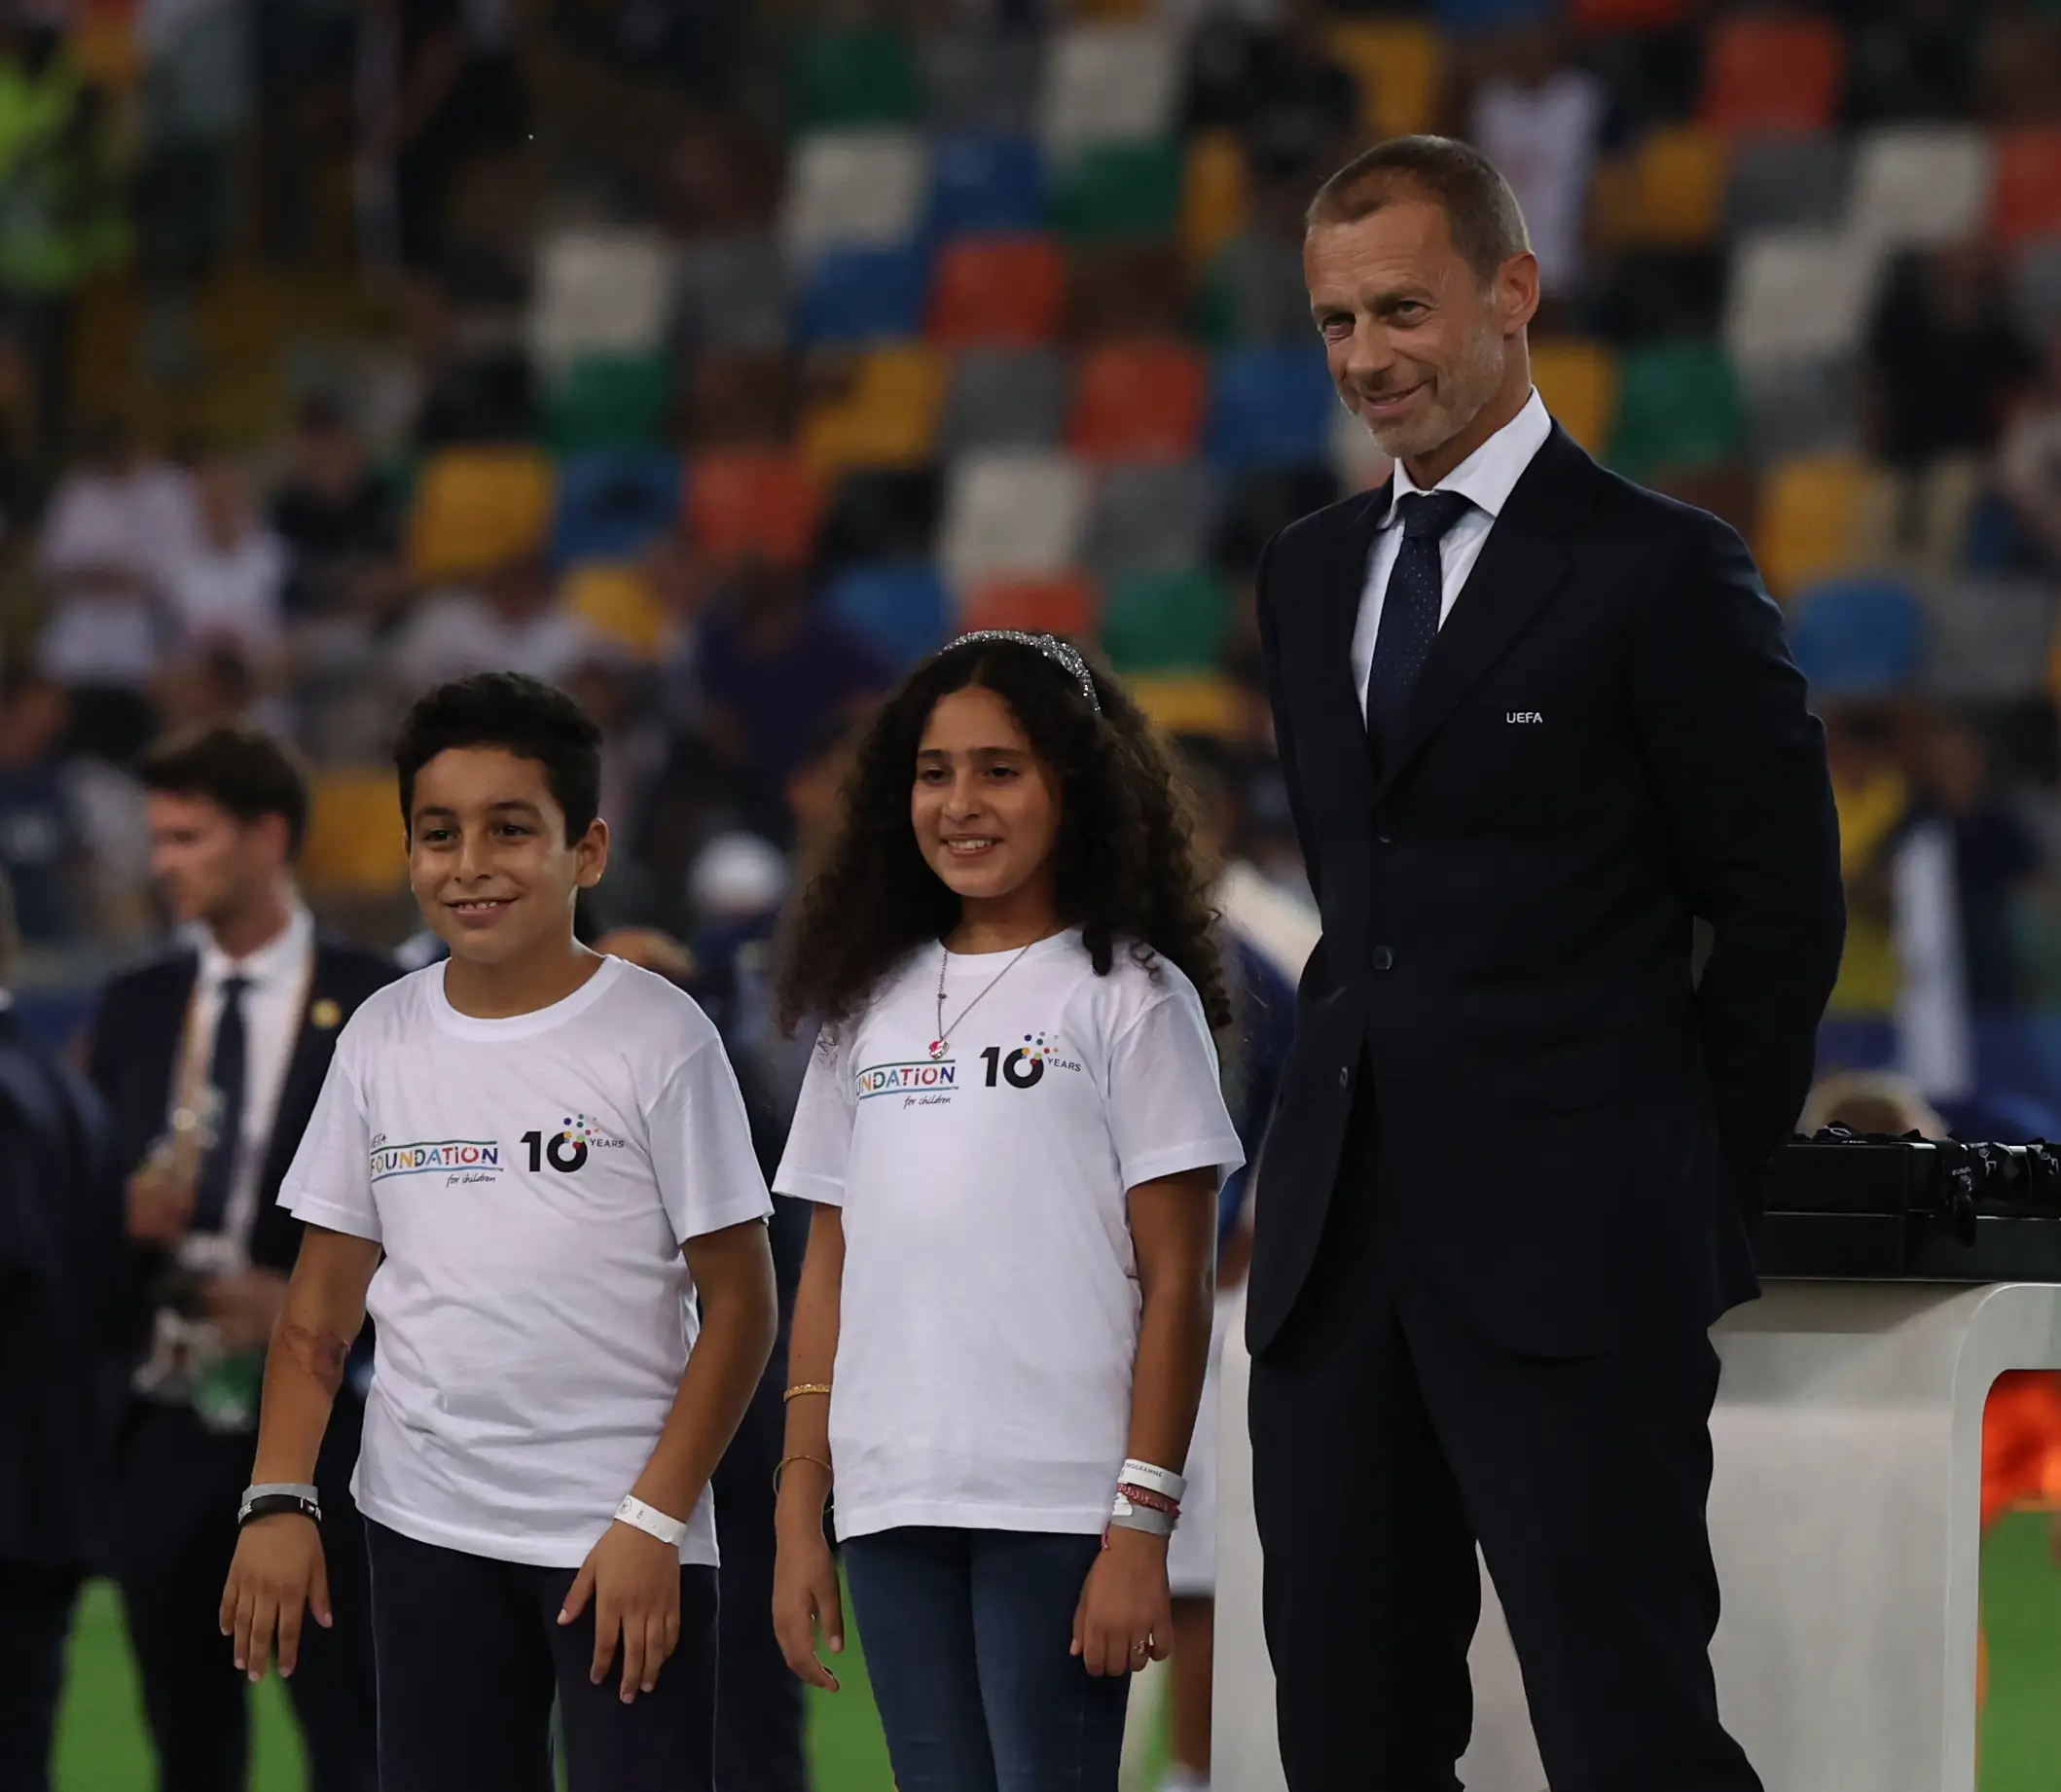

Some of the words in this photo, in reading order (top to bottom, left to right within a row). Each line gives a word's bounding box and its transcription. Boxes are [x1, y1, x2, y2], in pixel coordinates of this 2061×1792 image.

[1506, 712, 1543, 724] UEFA
[980, 1047, 1044, 1089] 10
[1048, 1057, 1082, 1072] YEARS
[856, 1066, 956, 1096] UNDATiON
[904, 1095, 918, 1109] for
[919, 1094, 951, 1105] children
[520, 1131, 588, 1173] 10
[590, 1137, 625, 1148] YEARS
[446, 1174, 460, 1188] for
[462, 1172, 496, 1183] children
